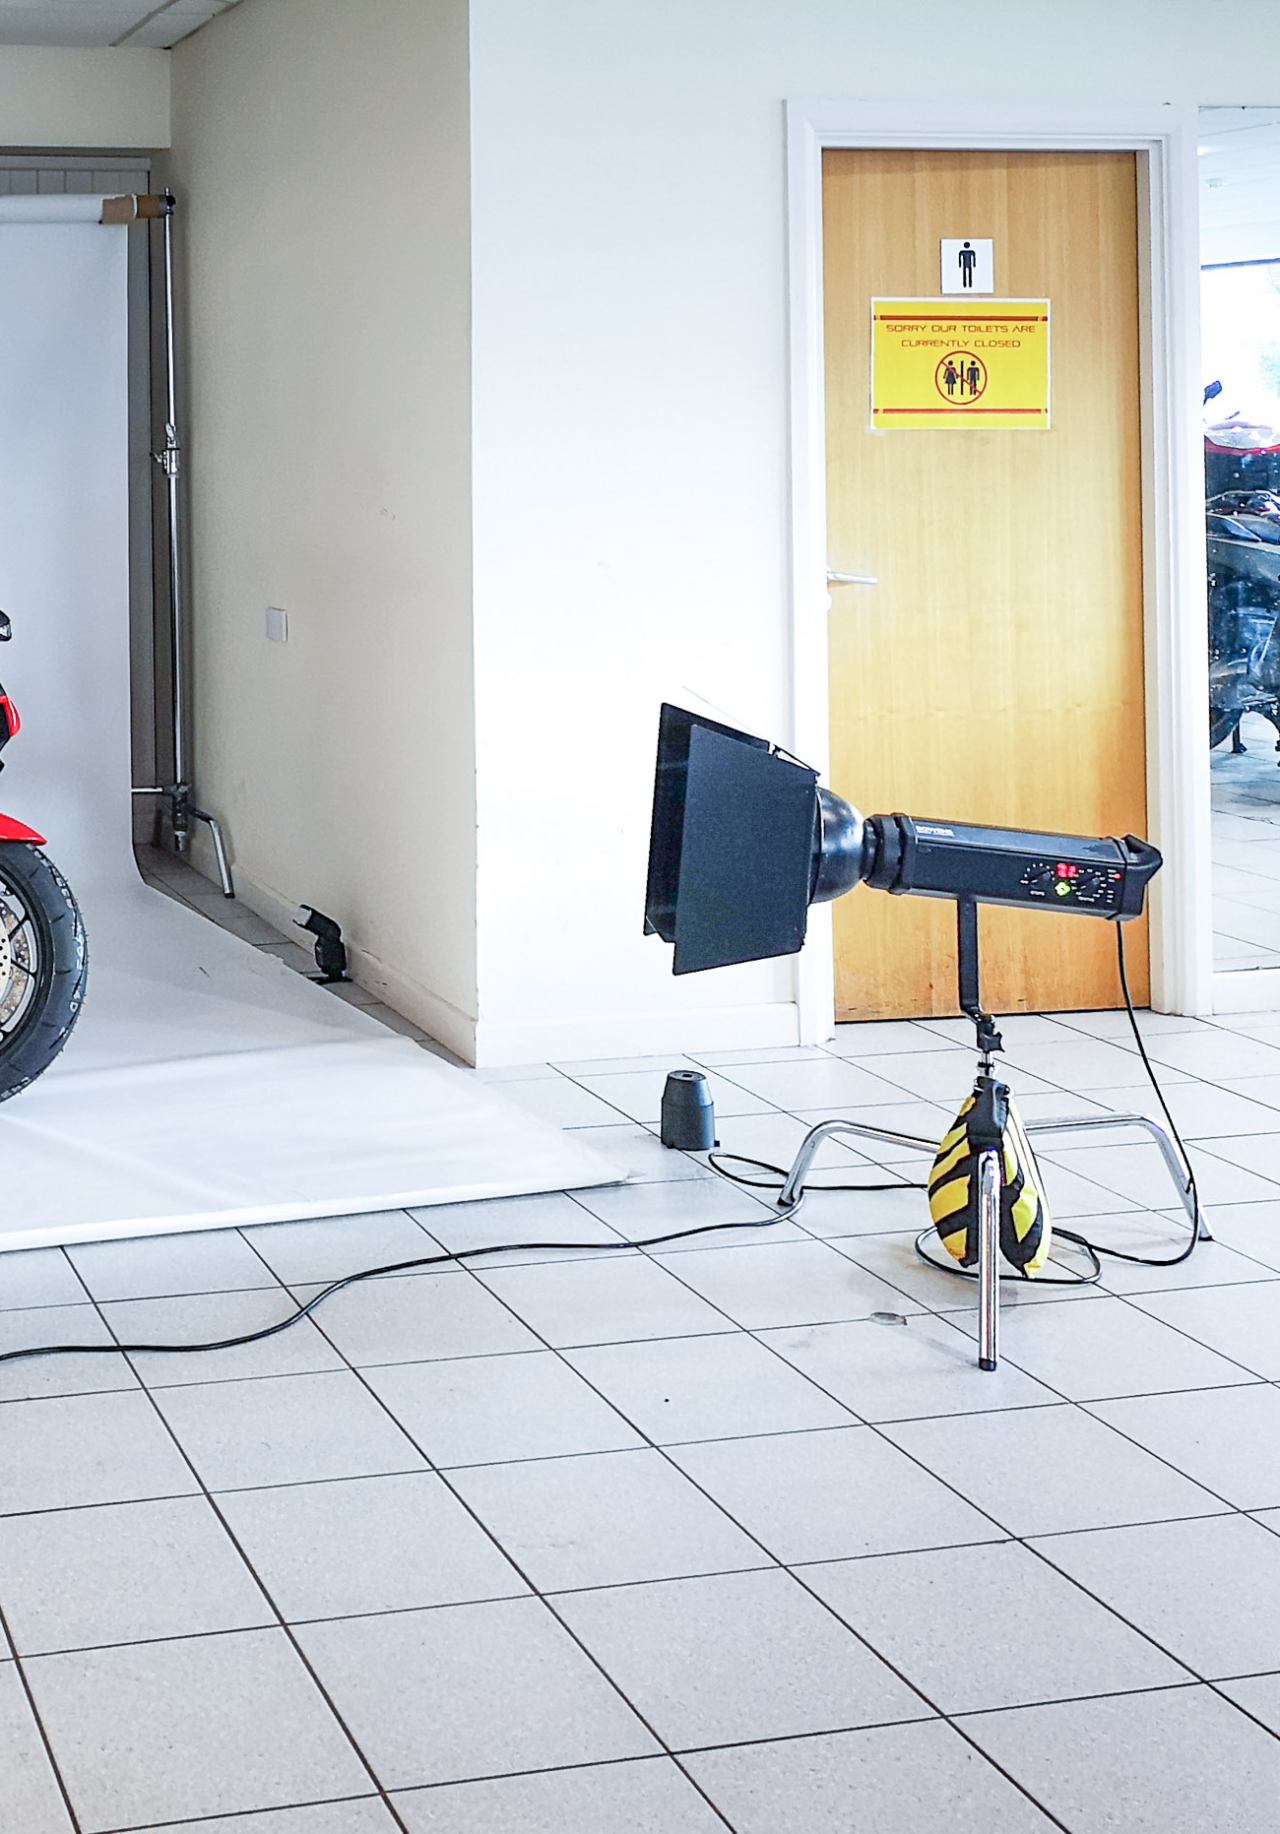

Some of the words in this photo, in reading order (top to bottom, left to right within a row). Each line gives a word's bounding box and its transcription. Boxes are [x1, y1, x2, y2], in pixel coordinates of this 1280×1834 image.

[886, 324, 926, 333] SORRY
[931, 324, 957, 333] OUR
[961, 325, 1009, 333] TOILETS
[1012, 325, 1036, 333] ARE
[901, 339, 969, 348] CURRENTLY
[974, 339, 1021, 348] CLOSED
